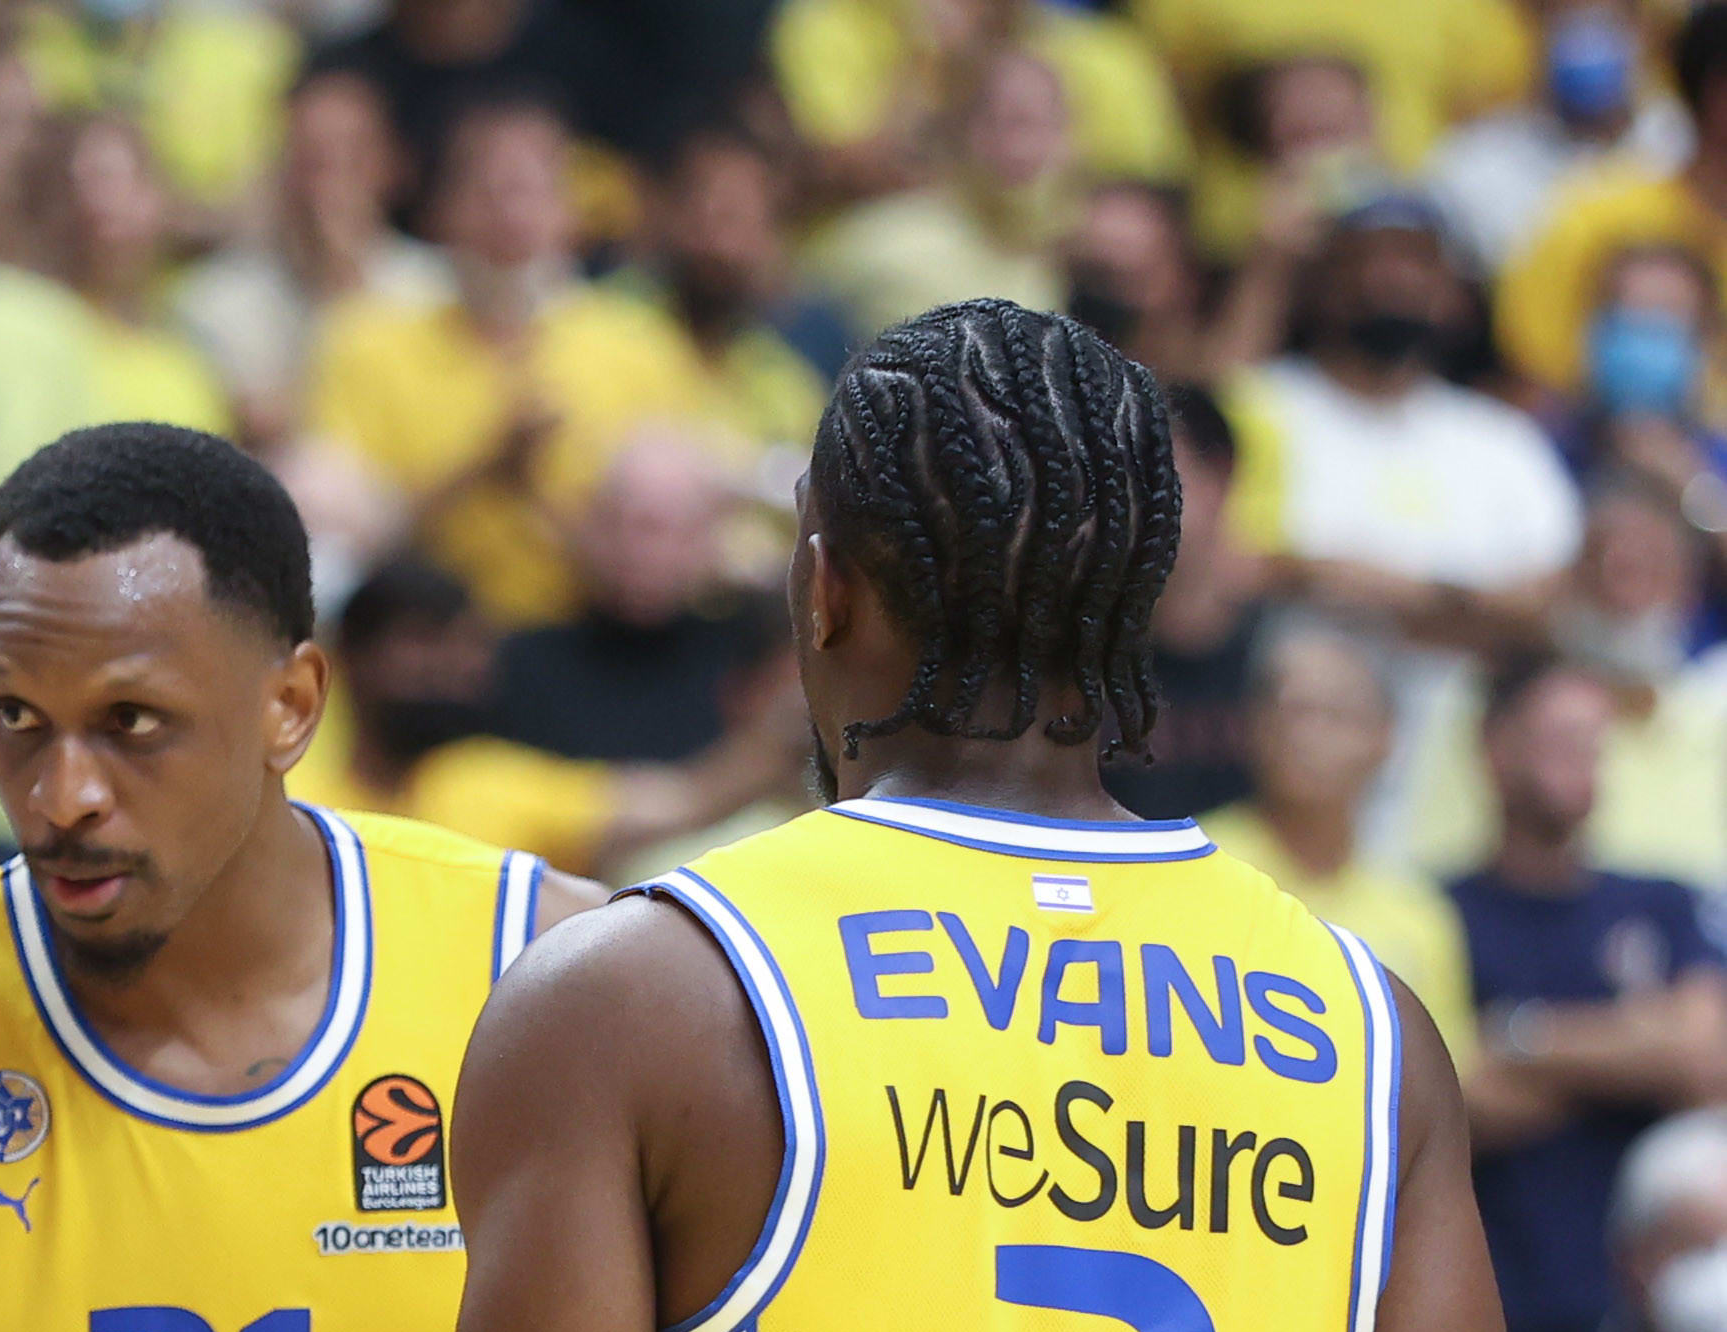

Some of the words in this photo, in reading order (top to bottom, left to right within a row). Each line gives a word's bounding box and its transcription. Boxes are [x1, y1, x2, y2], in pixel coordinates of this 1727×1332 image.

[837, 908, 1338, 1084] EVANS
[361, 1164, 439, 1183] TURKISH
[362, 1181, 440, 1197] AIRLINES
[885, 1079, 1316, 1247] weSure
